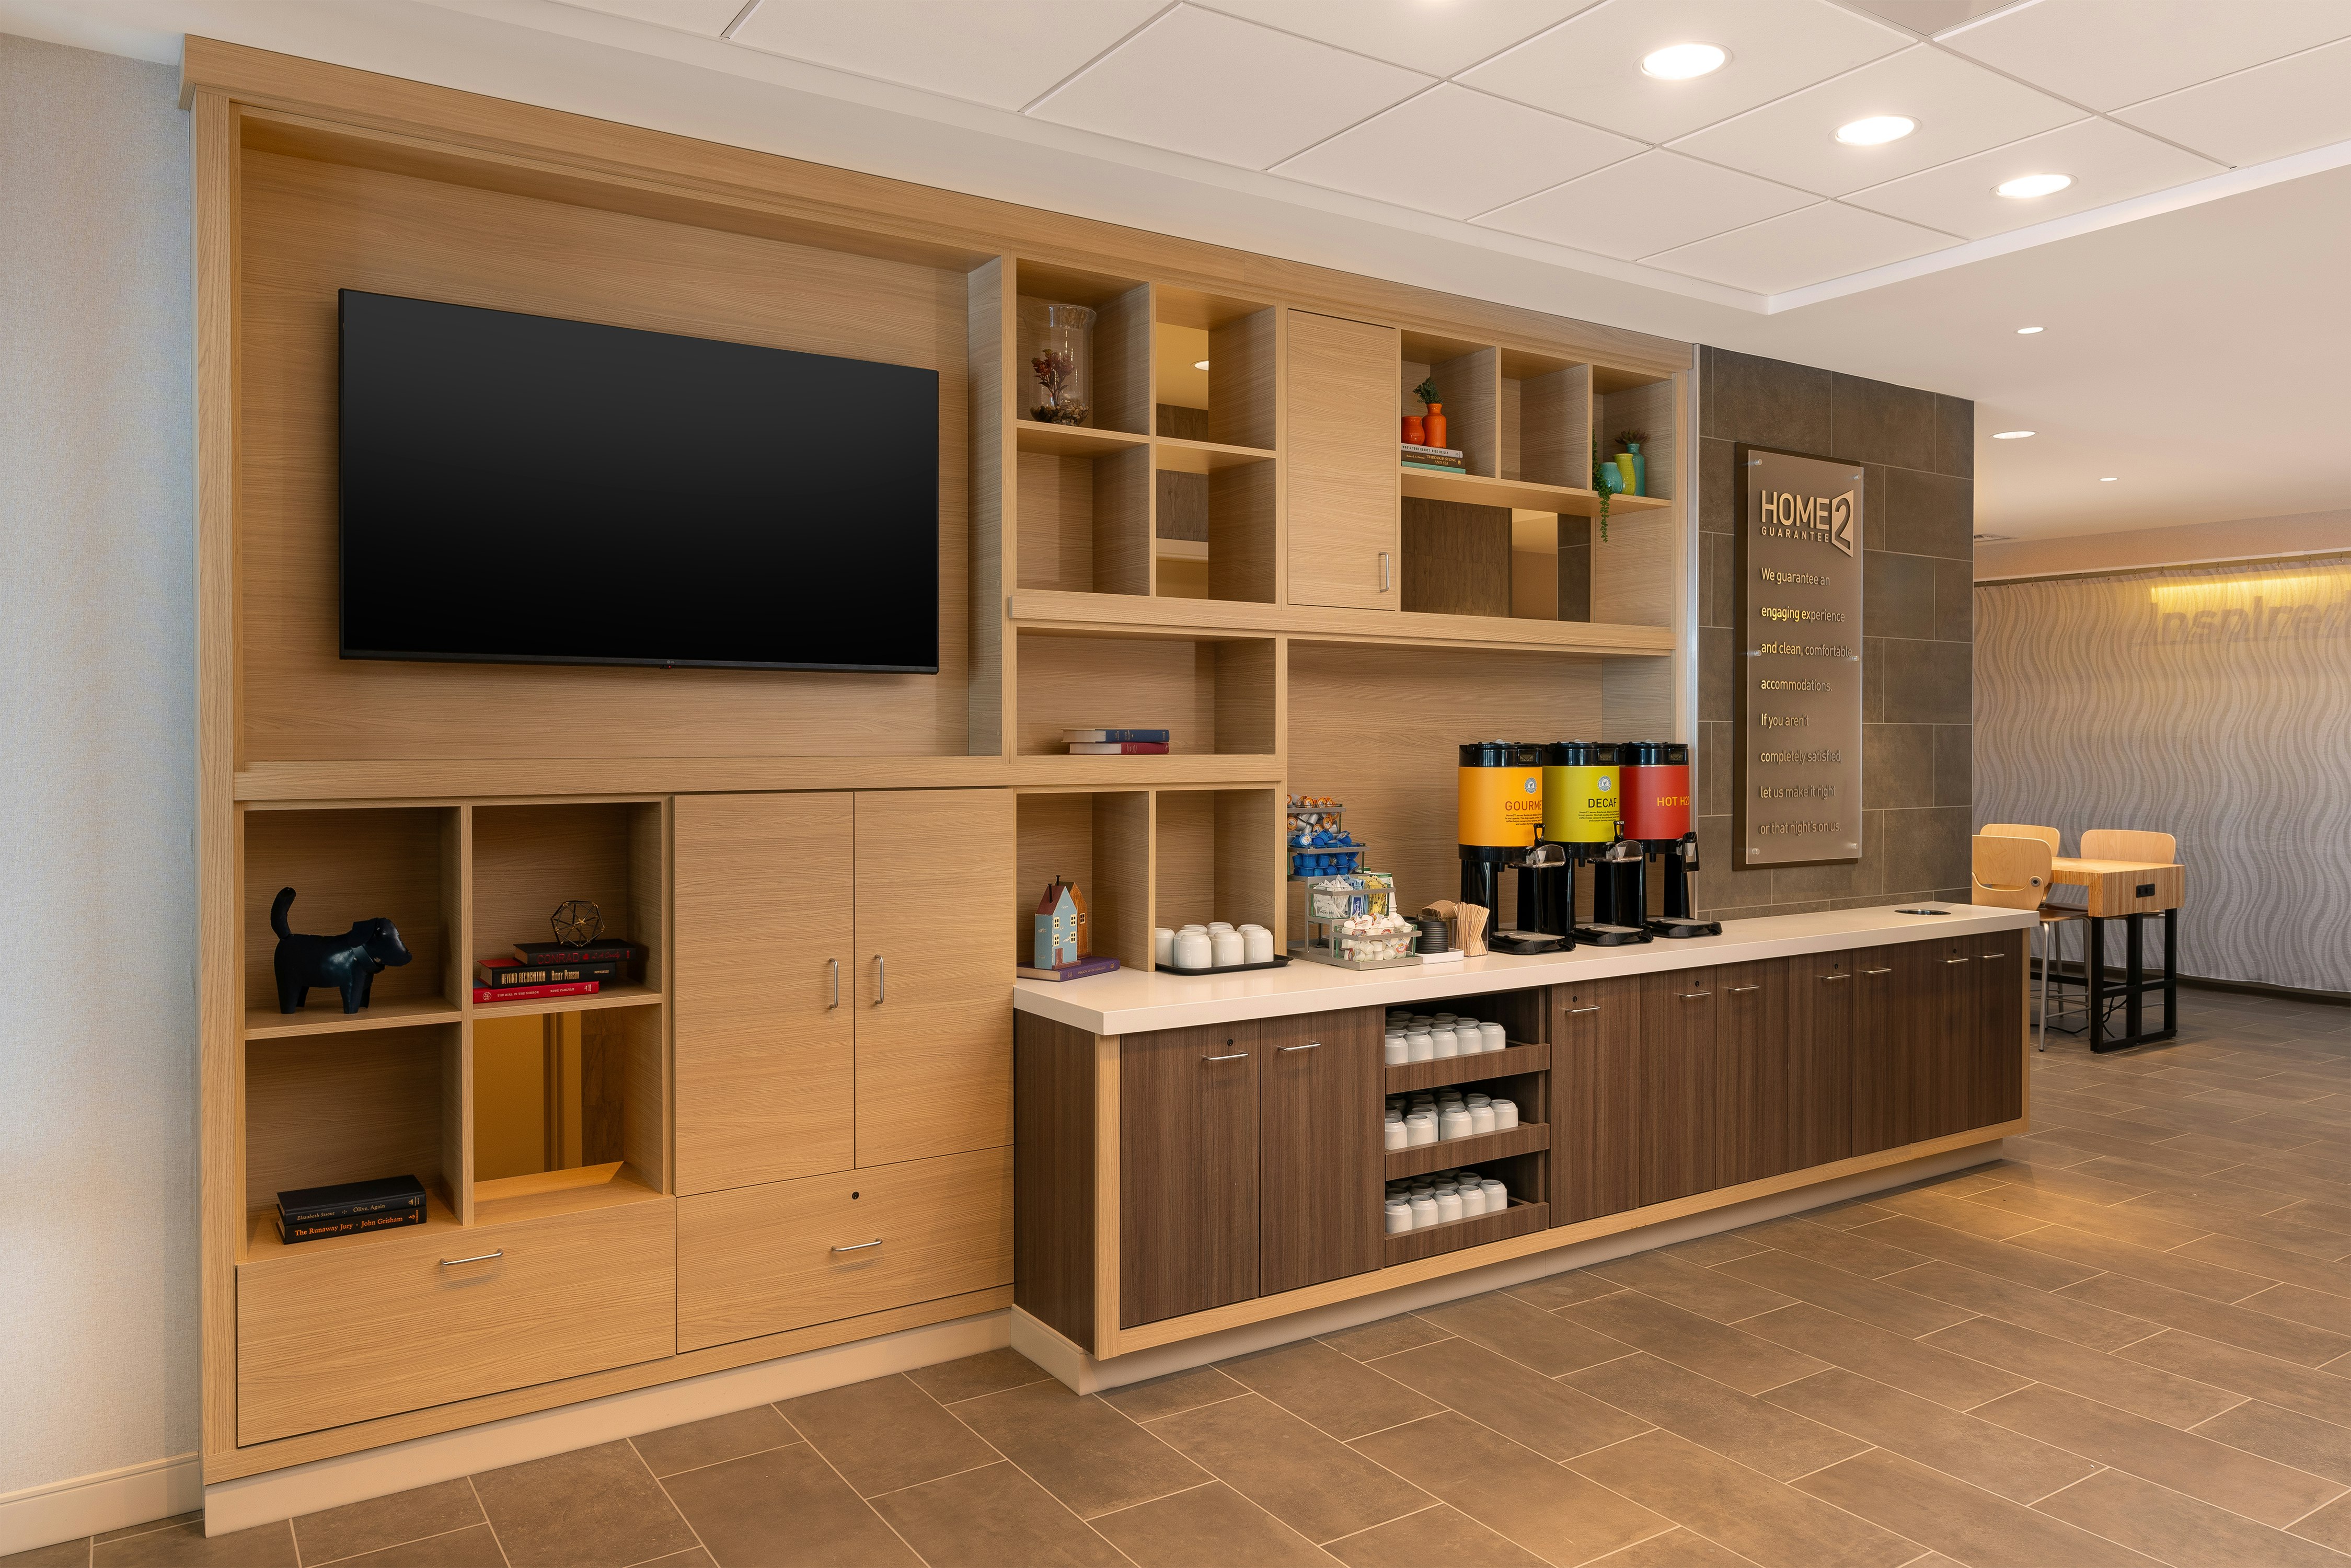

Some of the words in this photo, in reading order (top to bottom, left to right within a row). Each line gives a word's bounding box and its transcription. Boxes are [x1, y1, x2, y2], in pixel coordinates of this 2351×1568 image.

[1762, 526, 1829, 543] GUARANTEE
[1761, 567, 1774, 581] We
[1777, 572, 1818, 585] guarantee
[1820, 576, 1830, 586] an
[1761, 606, 1800, 622] engaging
[1801, 609, 1845, 623] experience
[1761, 641, 1777, 653] and
[1779, 642, 1803, 656] clean,
[1805, 644, 1852, 658] comfortable
[1761, 679, 1833, 691] accommodations.
[1761, 713, 1767, 725] If
[1768, 717, 1783, 729] you
[1785, 714, 1809, 726] aren't
[1761, 750, 1806, 765] completely
[1807, 750, 1843, 764] satisfied,
[1761, 786, 1771, 799] let
[1773, 788, 1783, 798] us
[1785, 786, 1808, 798] make
[1810, 786, 1815, 797] it
[1817, 785, 1836, 800] right
[1505, 800, 1542, 811] GOURME
[1588, 798, 1617, 808] DECAF
[1657, 797, 1678, 806] HOT
[1760, 825, 1770, 835] or
[1772, 822, 1788, 834] that
[1790, 821, 1817, 836] night's
[1818, 823, 1828, 832] on
[1830, 822, 1841, 832] us.
[537, 953, 580, 964] CONRAD
[501, 973, 517, 984] BEYOND
[519, 971, 546, 983] RECOGNITION
[309, 1225, 338, 1235] Runaway
[340, 1223, 353, 1231] Jury
[361, 1220, 376, 1228] John
[377, 1216, 403, 1225] Grisham
